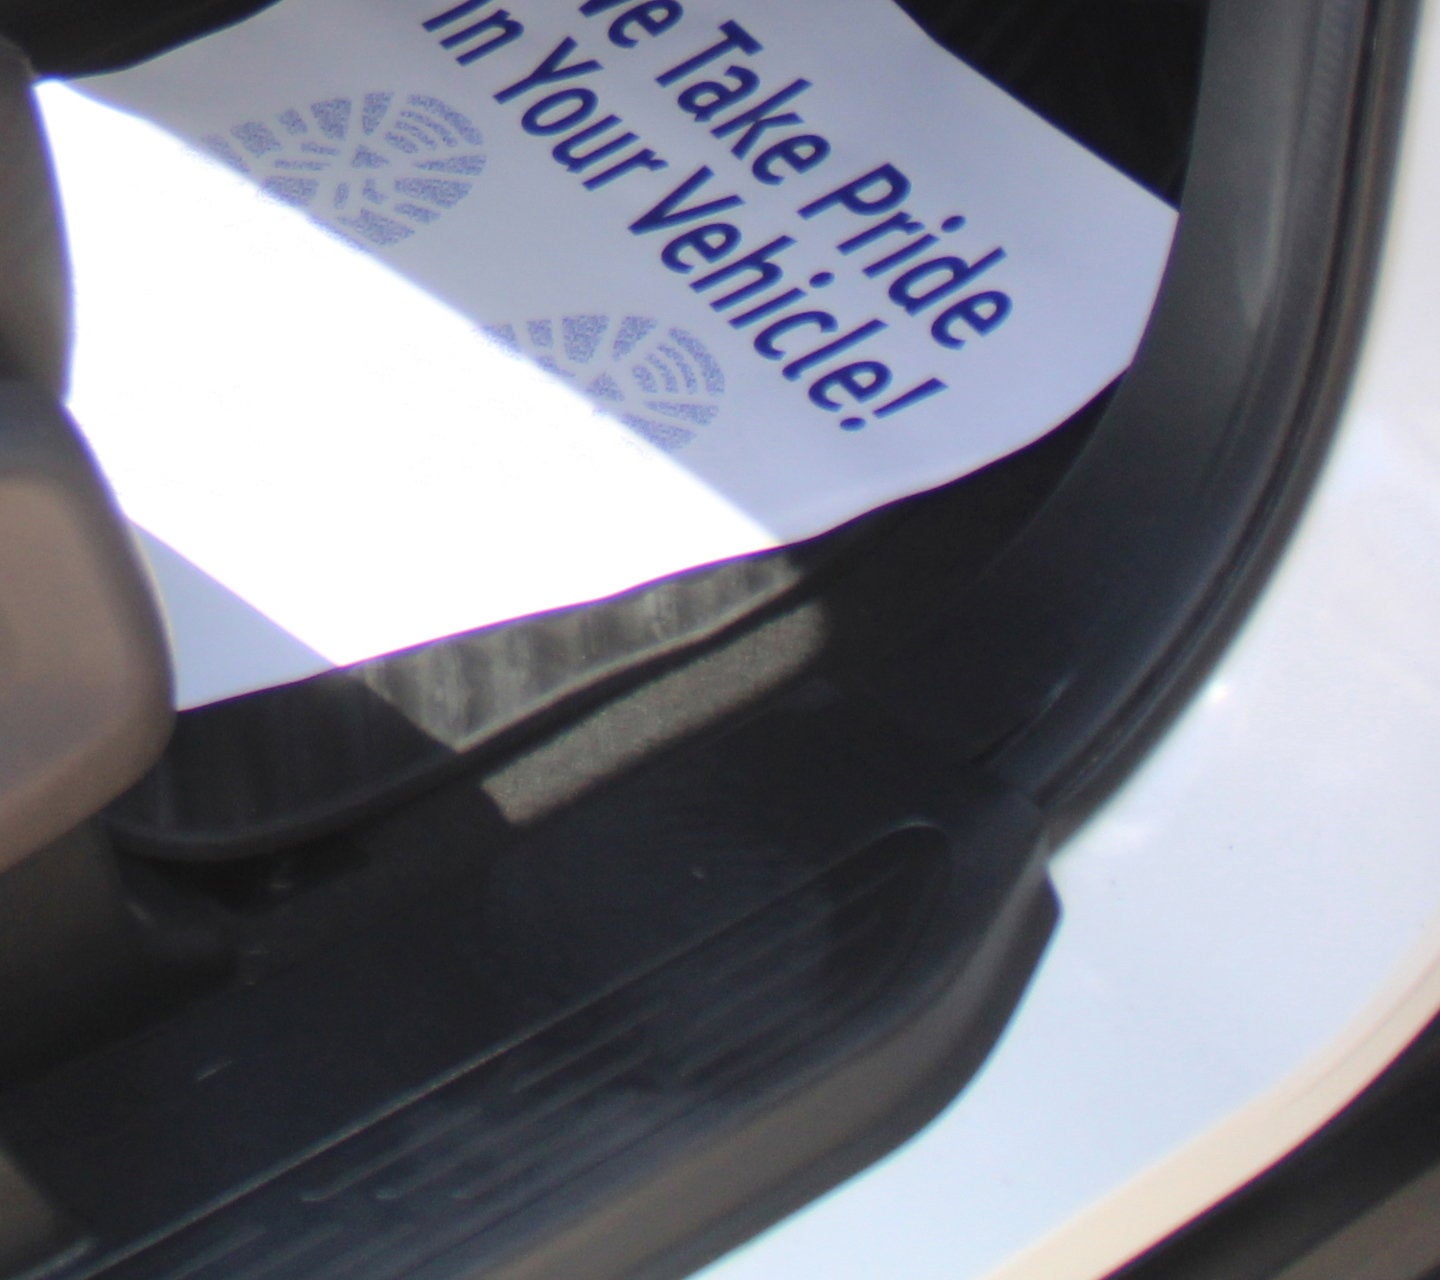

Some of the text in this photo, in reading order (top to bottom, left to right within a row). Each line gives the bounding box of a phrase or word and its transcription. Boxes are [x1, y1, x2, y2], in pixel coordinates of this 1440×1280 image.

[492, 35, 669, 192] Your
[628, 164, 949, 433] Vehicle!
[654, 18, 832, 186] Take
[797, 162, 1013, 350] Pride
